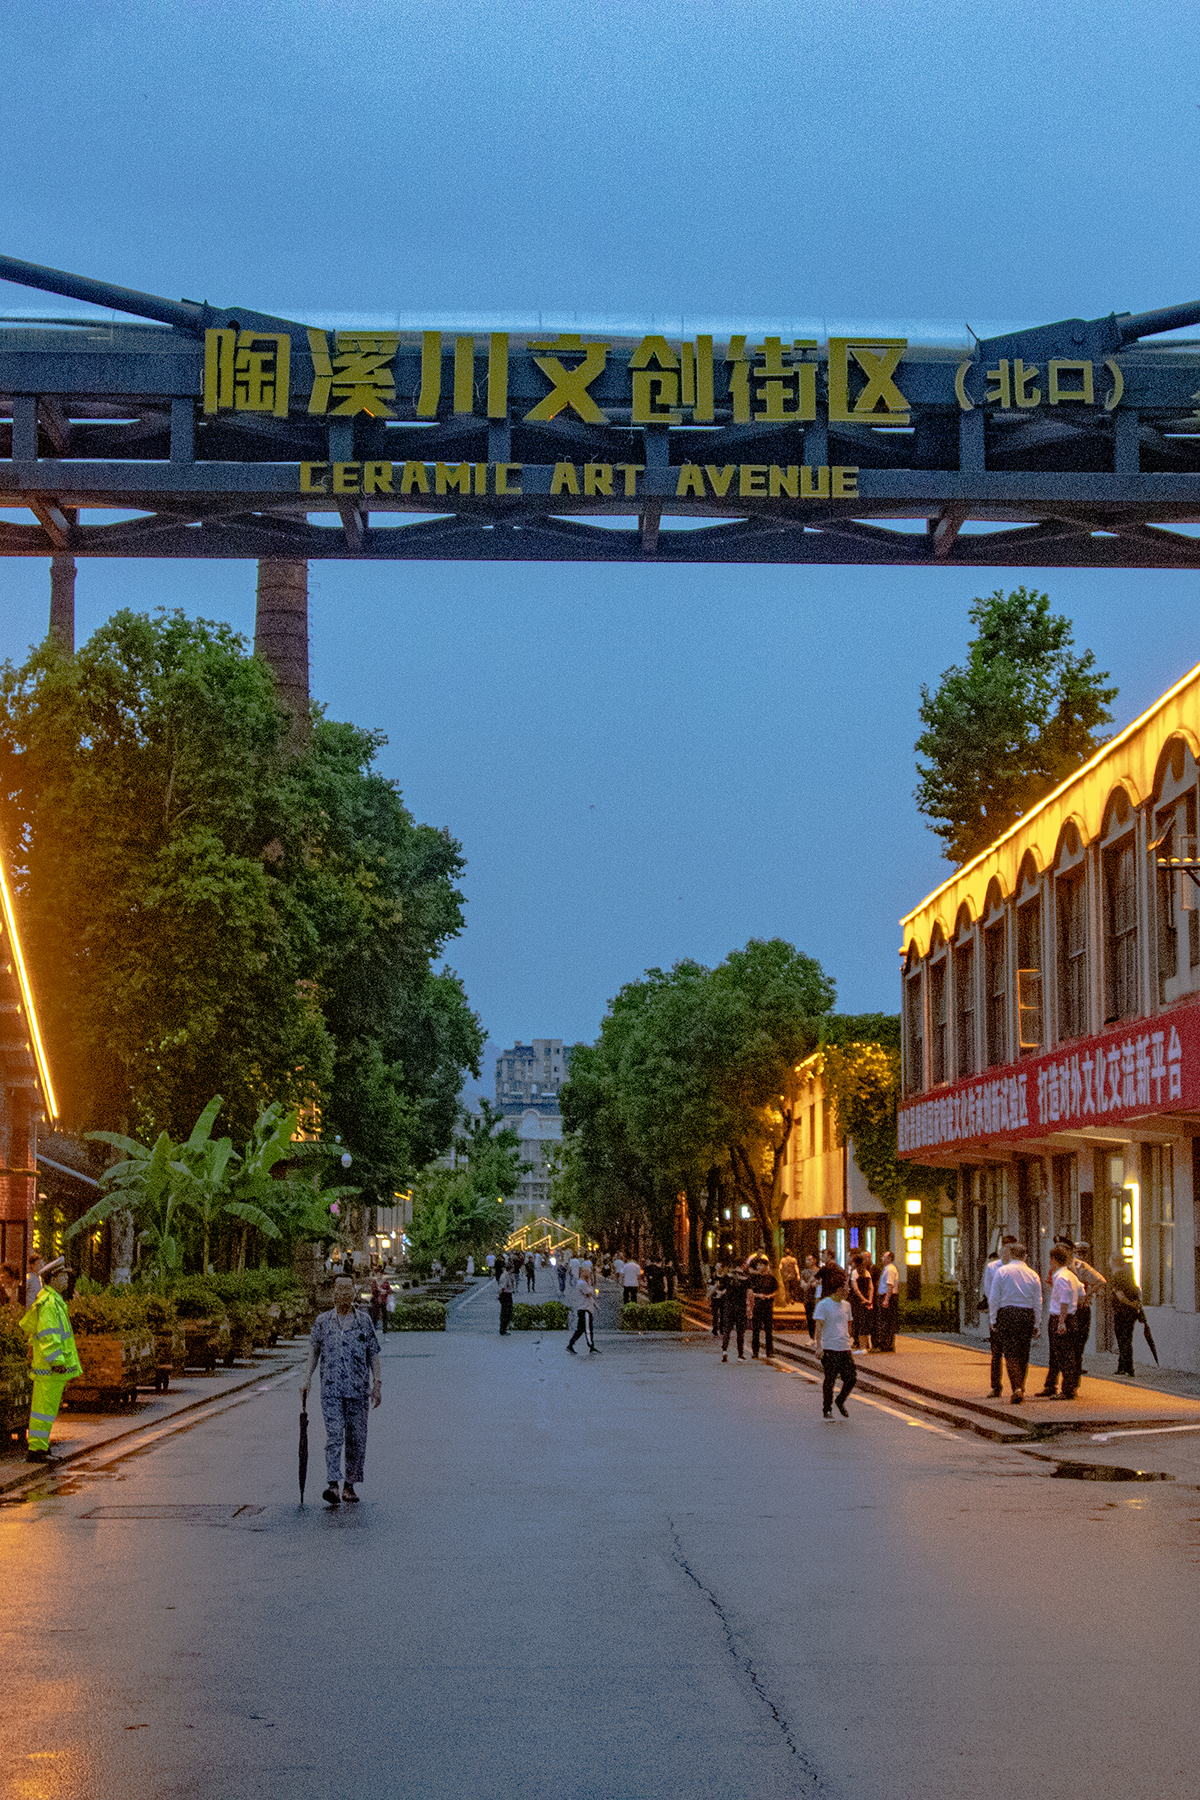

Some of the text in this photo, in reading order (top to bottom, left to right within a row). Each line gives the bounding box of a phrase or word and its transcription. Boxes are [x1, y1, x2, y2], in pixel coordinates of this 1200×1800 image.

[204, 329, 911, 424] 陶溪川文创街区
[300, 461, 859, 498] CERAMIC ART AVENUE
[1037, 1025, 1182, 1125] 打造对外文化交流新平台
